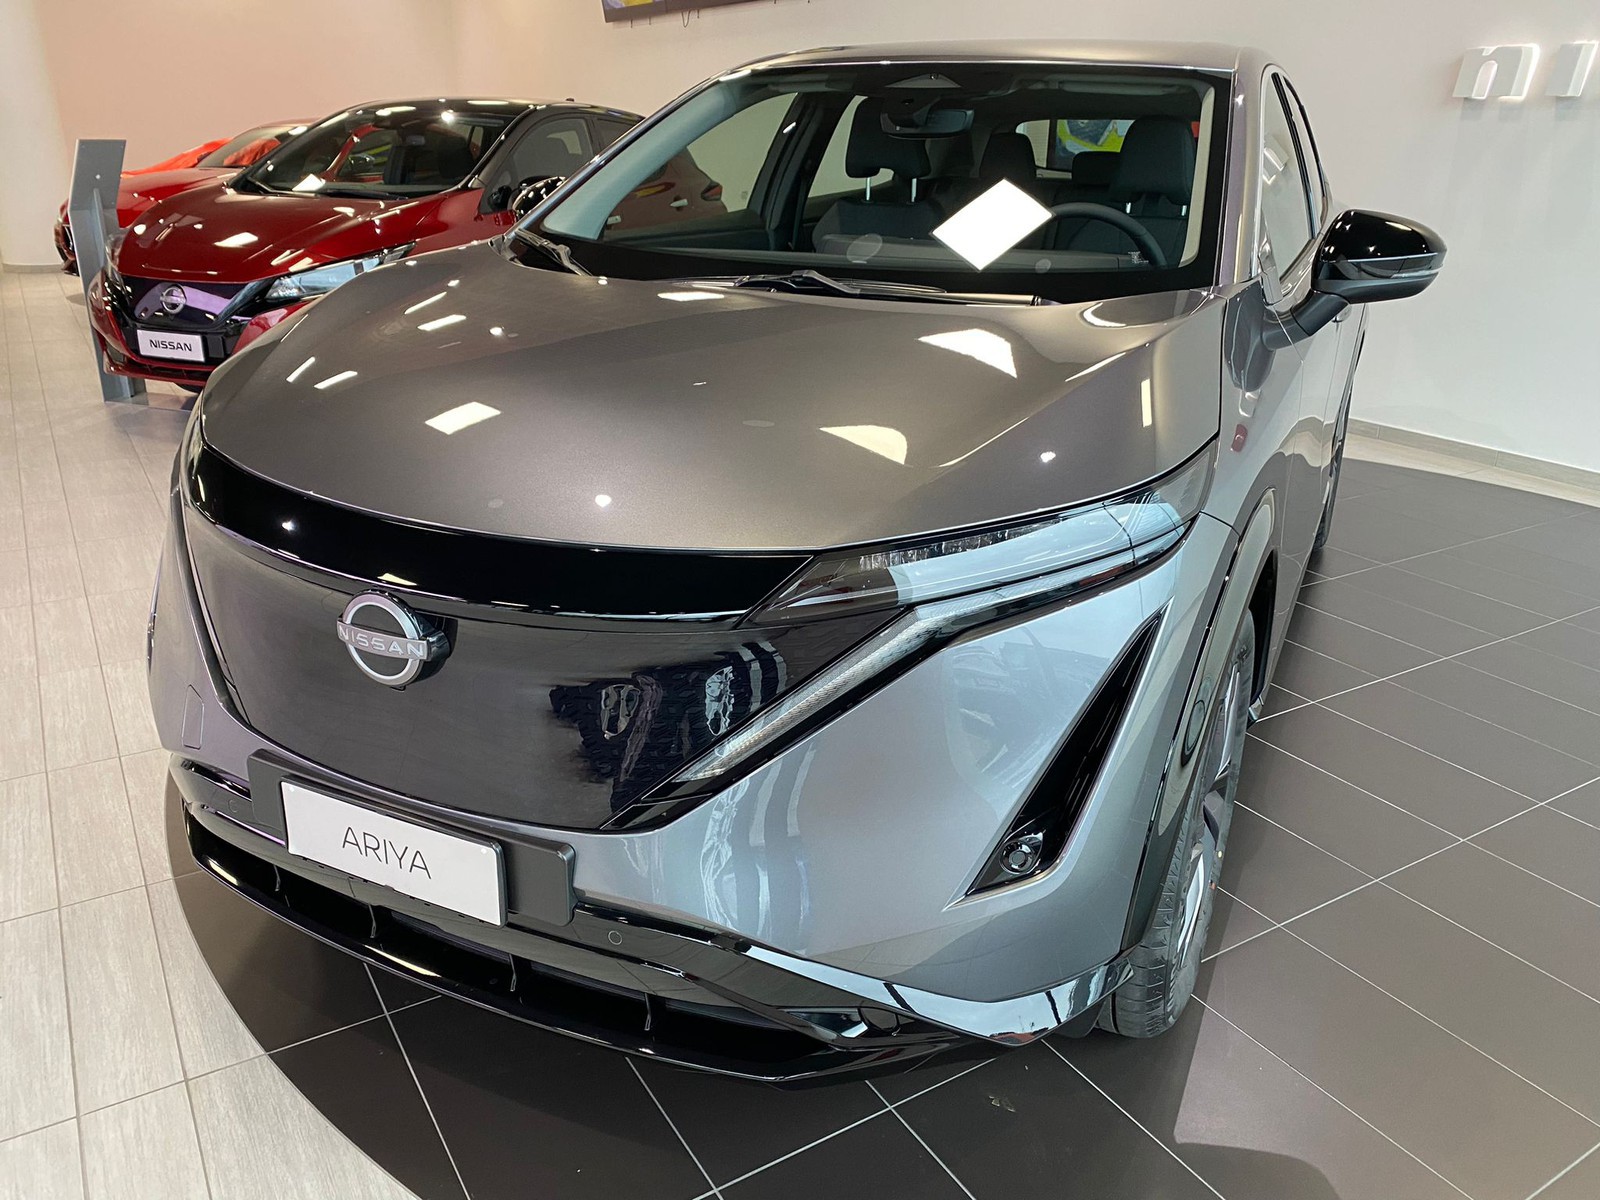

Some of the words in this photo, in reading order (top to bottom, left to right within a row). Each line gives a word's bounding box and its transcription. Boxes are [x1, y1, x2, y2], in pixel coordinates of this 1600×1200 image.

[149, 339, 192, 352] NISSAN
[338, 625, 424, 658] NISSAN
[342, 826, 432, 880] ARIYA
